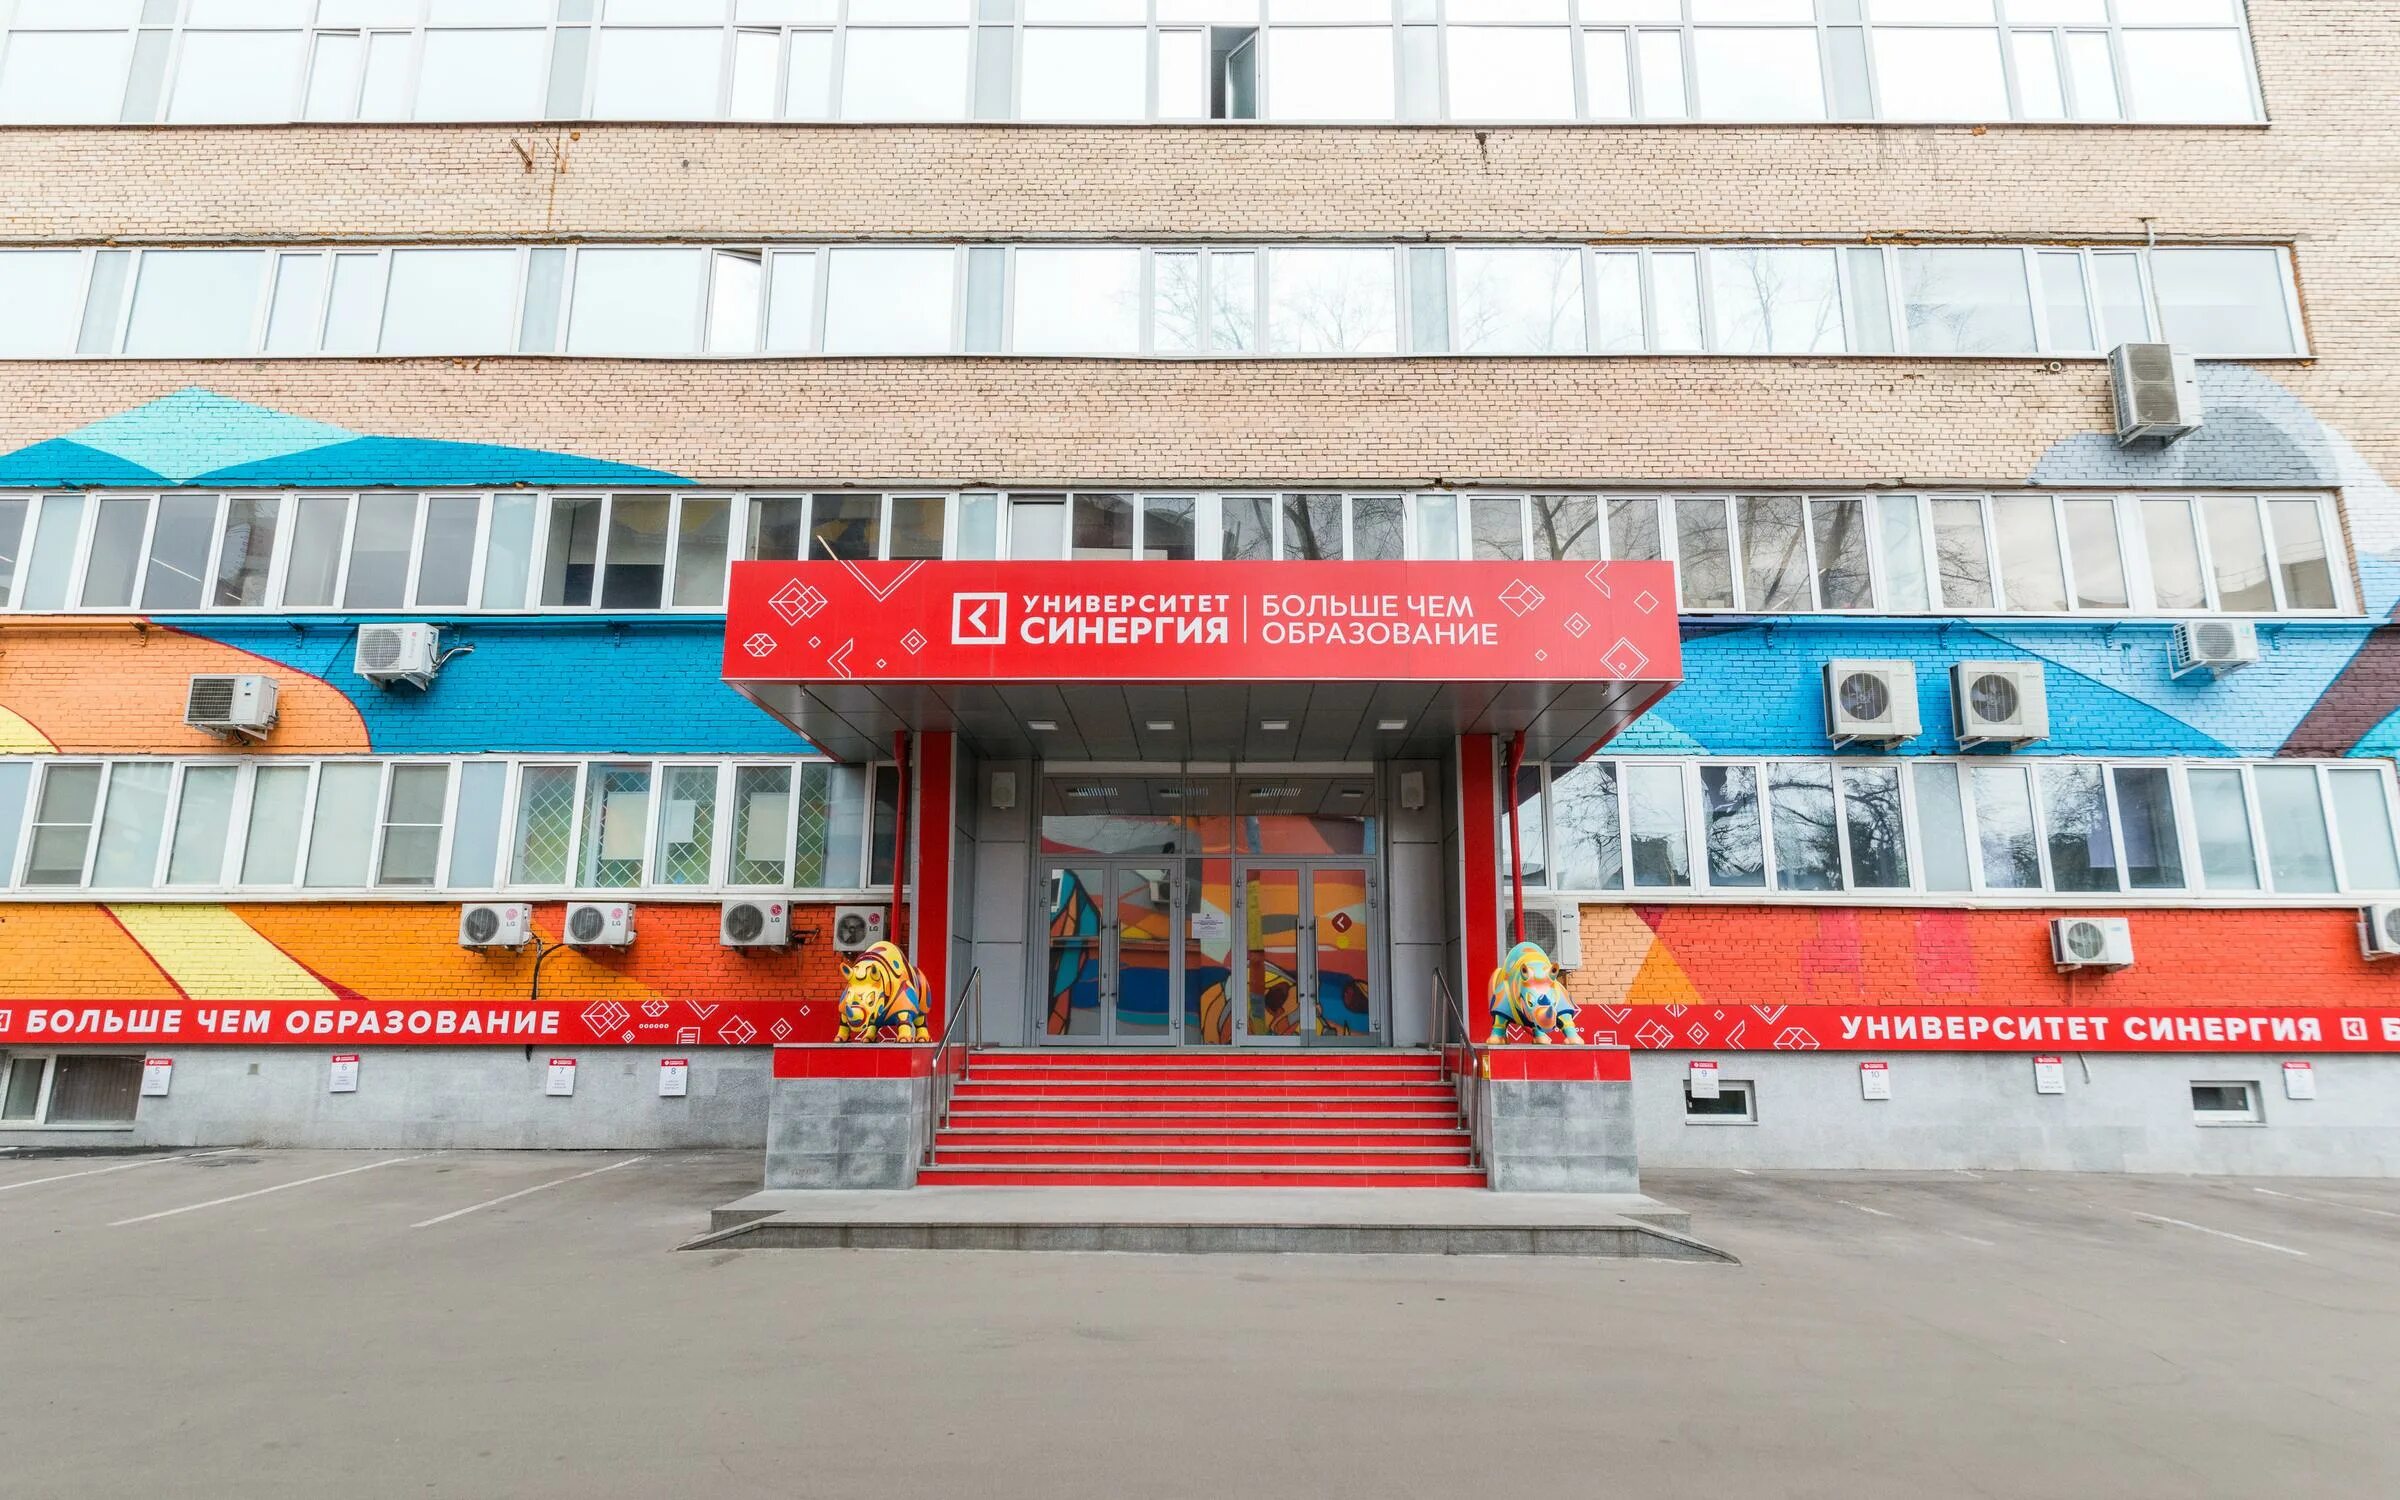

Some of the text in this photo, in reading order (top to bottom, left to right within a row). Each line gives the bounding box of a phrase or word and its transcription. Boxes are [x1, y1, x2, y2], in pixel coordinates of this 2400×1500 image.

[1022, 594, 1230, 613] УНИВЕРСИТЕТ
[1262, 594, 1474, 618] БОЛЬШЕ ЧЕМ
[1020, 616, 1229, 645] СИНЕРГИЯ
[1261, 621, 1499, 646] ОБРАЗОВАНИЕ
[25, 1009, 560, 1034] БОЛЬШЕ ЧЕМ ОБРАЗОВАНИЕ
[1840, 1015, 2322, 1042] УНИВЕРСИТЕТ СИНЕРГИЯ
[154, 1067, 161, 1075] 5
[559, 1067, 565, 1075] 7
[670, 1067, 677, 1075] 8
